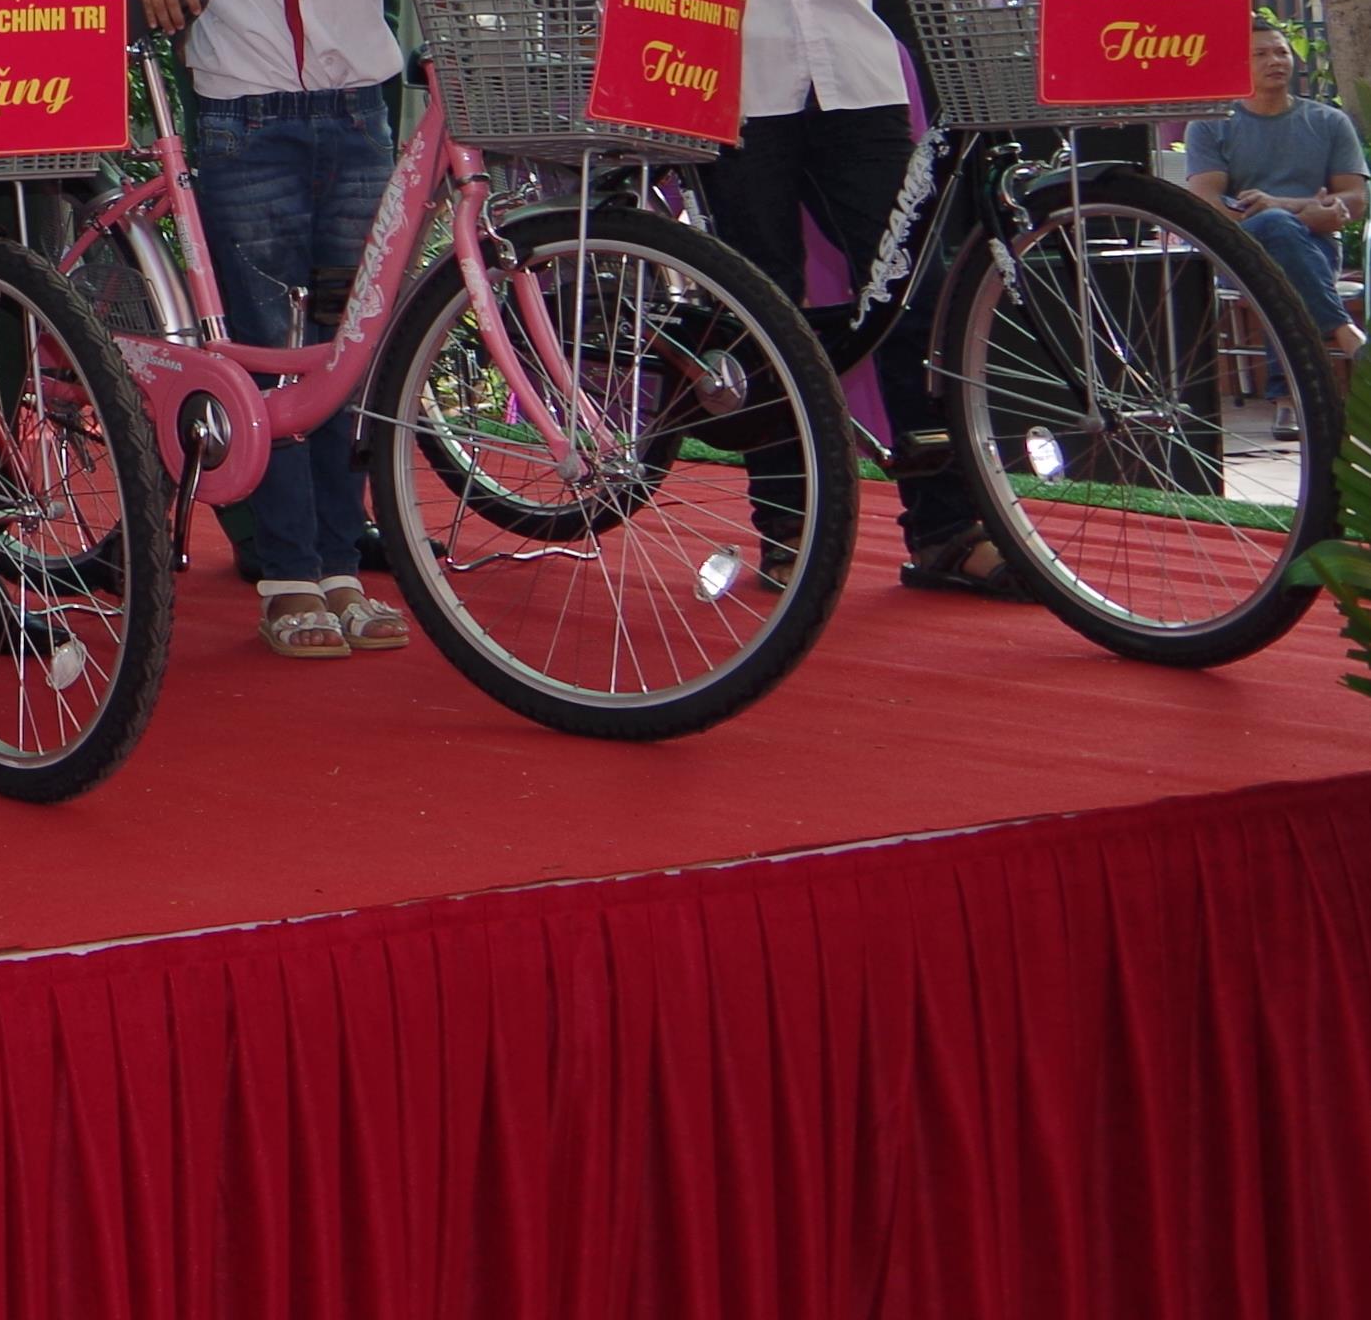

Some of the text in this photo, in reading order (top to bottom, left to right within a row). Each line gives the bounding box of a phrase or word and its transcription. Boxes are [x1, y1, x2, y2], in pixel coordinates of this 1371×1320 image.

[71, 5, 107, 34] TRỊ
[723, 5, 741, 36] TRỊ
[1100, 20, 1208, 70] Tặng
[641, 39, 719, 102] Tặng
